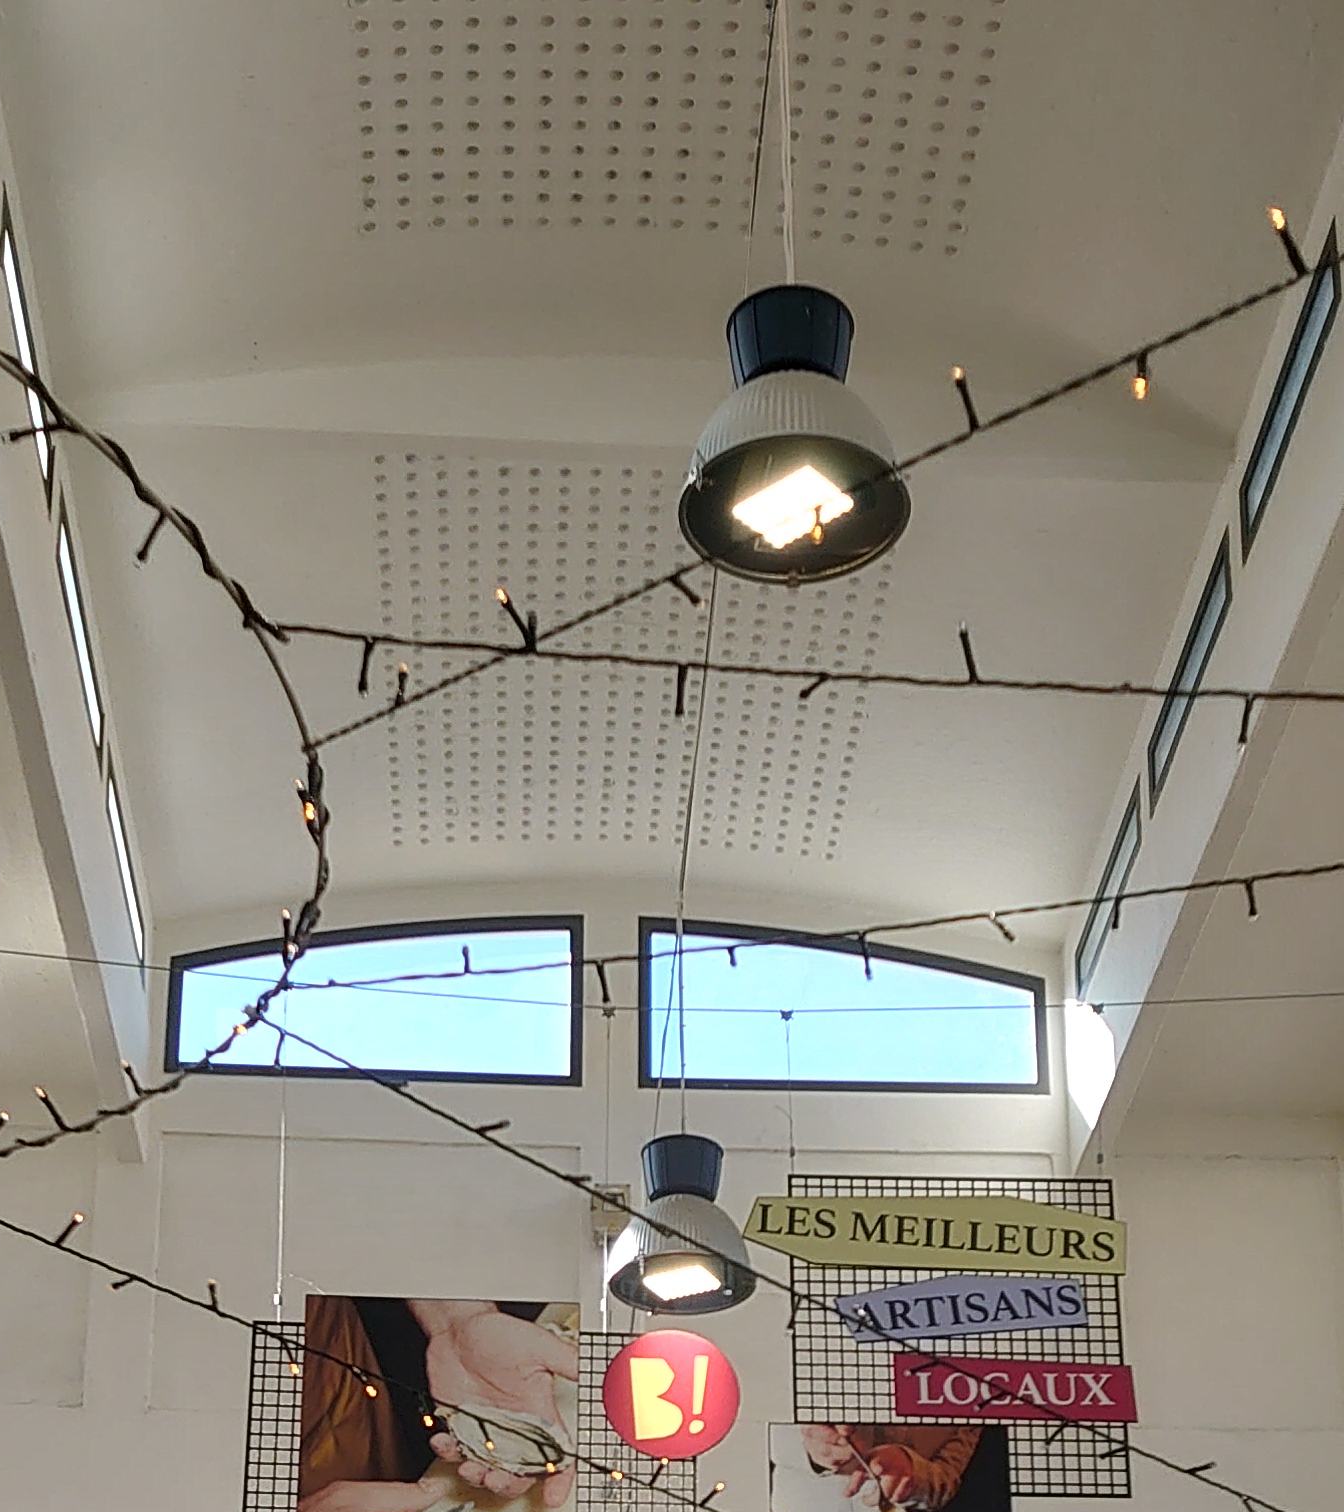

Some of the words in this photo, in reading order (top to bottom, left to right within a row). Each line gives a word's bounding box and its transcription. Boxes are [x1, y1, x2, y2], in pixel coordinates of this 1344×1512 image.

[756, 1203, 836, 1239] LES
[849, 1211, 1116, 1263] MEILLEURS
[855, 1283, 1083, 1334] ARTISANS
[916, 1372, 1116, 1406] LOCAUX
